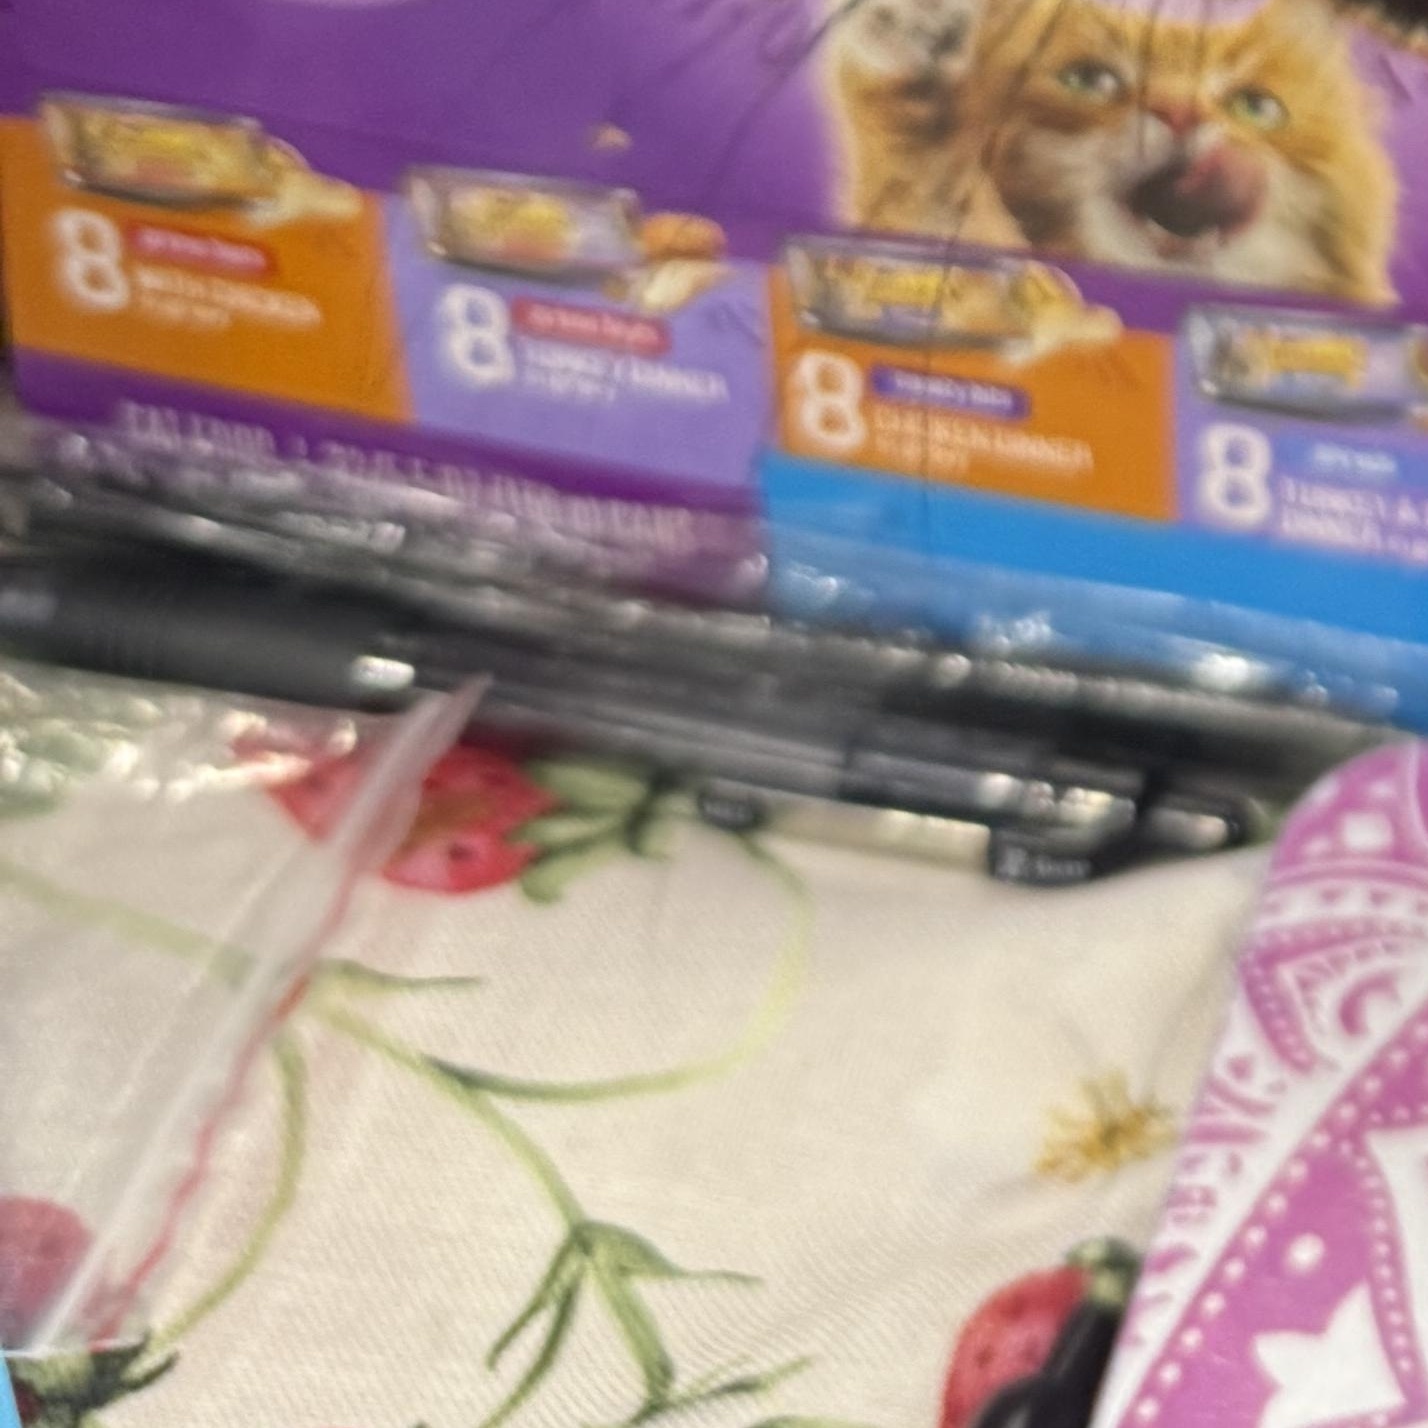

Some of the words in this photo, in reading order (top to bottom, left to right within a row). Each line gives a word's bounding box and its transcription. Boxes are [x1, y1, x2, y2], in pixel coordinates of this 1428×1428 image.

[56, 208, 130, 312] 8
[442, 283, 515, 386] 8
[796, 350, 868, 453] 8
[1201, 422, 1273, 527] 8
